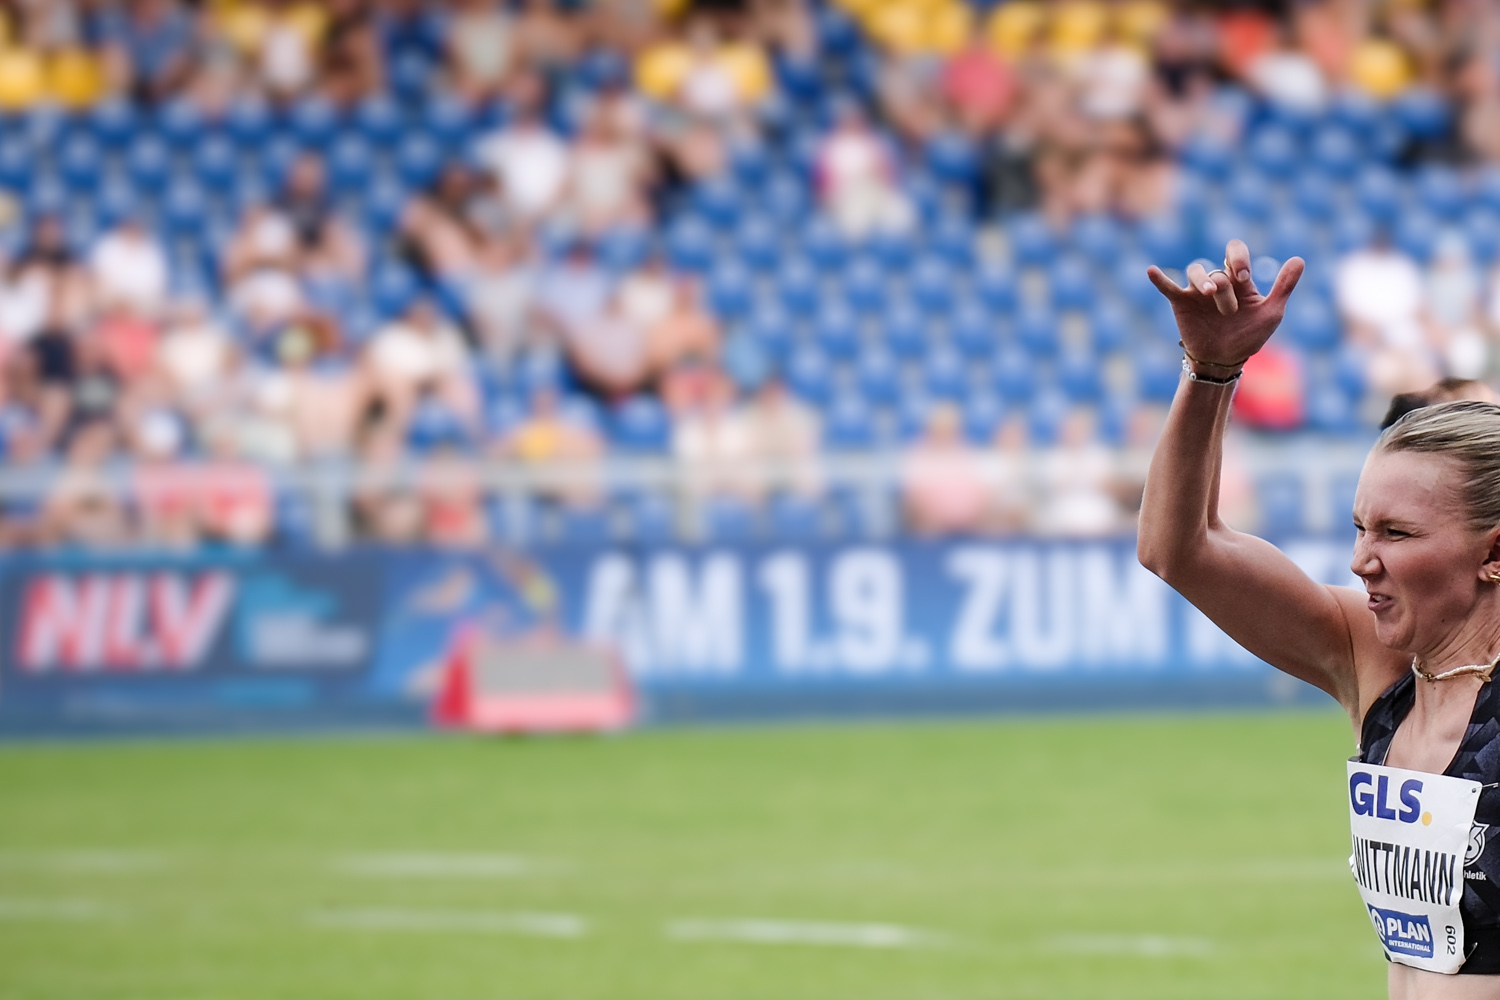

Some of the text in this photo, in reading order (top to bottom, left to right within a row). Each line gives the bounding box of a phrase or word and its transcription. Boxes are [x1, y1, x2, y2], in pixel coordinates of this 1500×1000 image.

[17, 570, 240, 671] NLV
[586, 550, 746, 674] AM
[758, 550, 930, 670] 1.9.
[948, 548, 1170, 670] ZUM
[1352, 833, 1456, 906] WITTMANN
[1386, 917, 1431, 943] PLAN
[1388, 939, 1431, 953] INTERNATIONAL
[1444, 924, 1457, 955] 602
